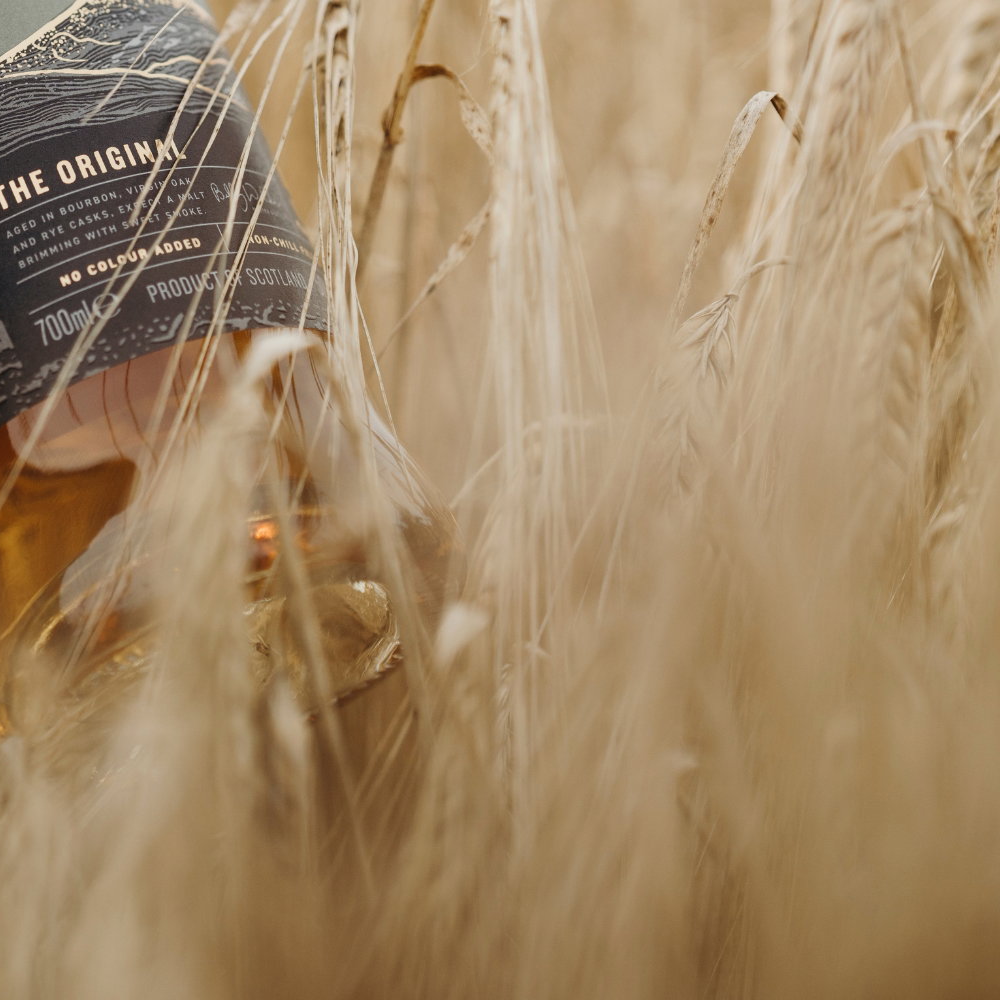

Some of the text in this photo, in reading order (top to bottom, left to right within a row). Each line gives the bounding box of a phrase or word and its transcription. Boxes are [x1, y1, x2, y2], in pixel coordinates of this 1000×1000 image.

[56, 138, 187, 185] ORIGINAL
[6, 219, 37, 240] AGED
[41, 211, 55, 223] IN
[59, 191, 122, 216] BOURBON,
[171, 177, 193, 188] OAK
[12, 237, 37, 255] AND
[41, 225, 65, 241] RYE
[69, 210, 115, 230] CASKS,
[167, 195, 175, 204] A
[177, 191, 206, 202] MALT
[18, 236, 81, 269] BRIMMING
[85, 225, 118, 242] WITH
[59, 237, 202, 288] NO COLOUR ADDED
[145, 270, 222, 304] PRODUCT
[245, 267, 309, 290] SCOTLAND
[34, 299, 95, 347] 700ml
